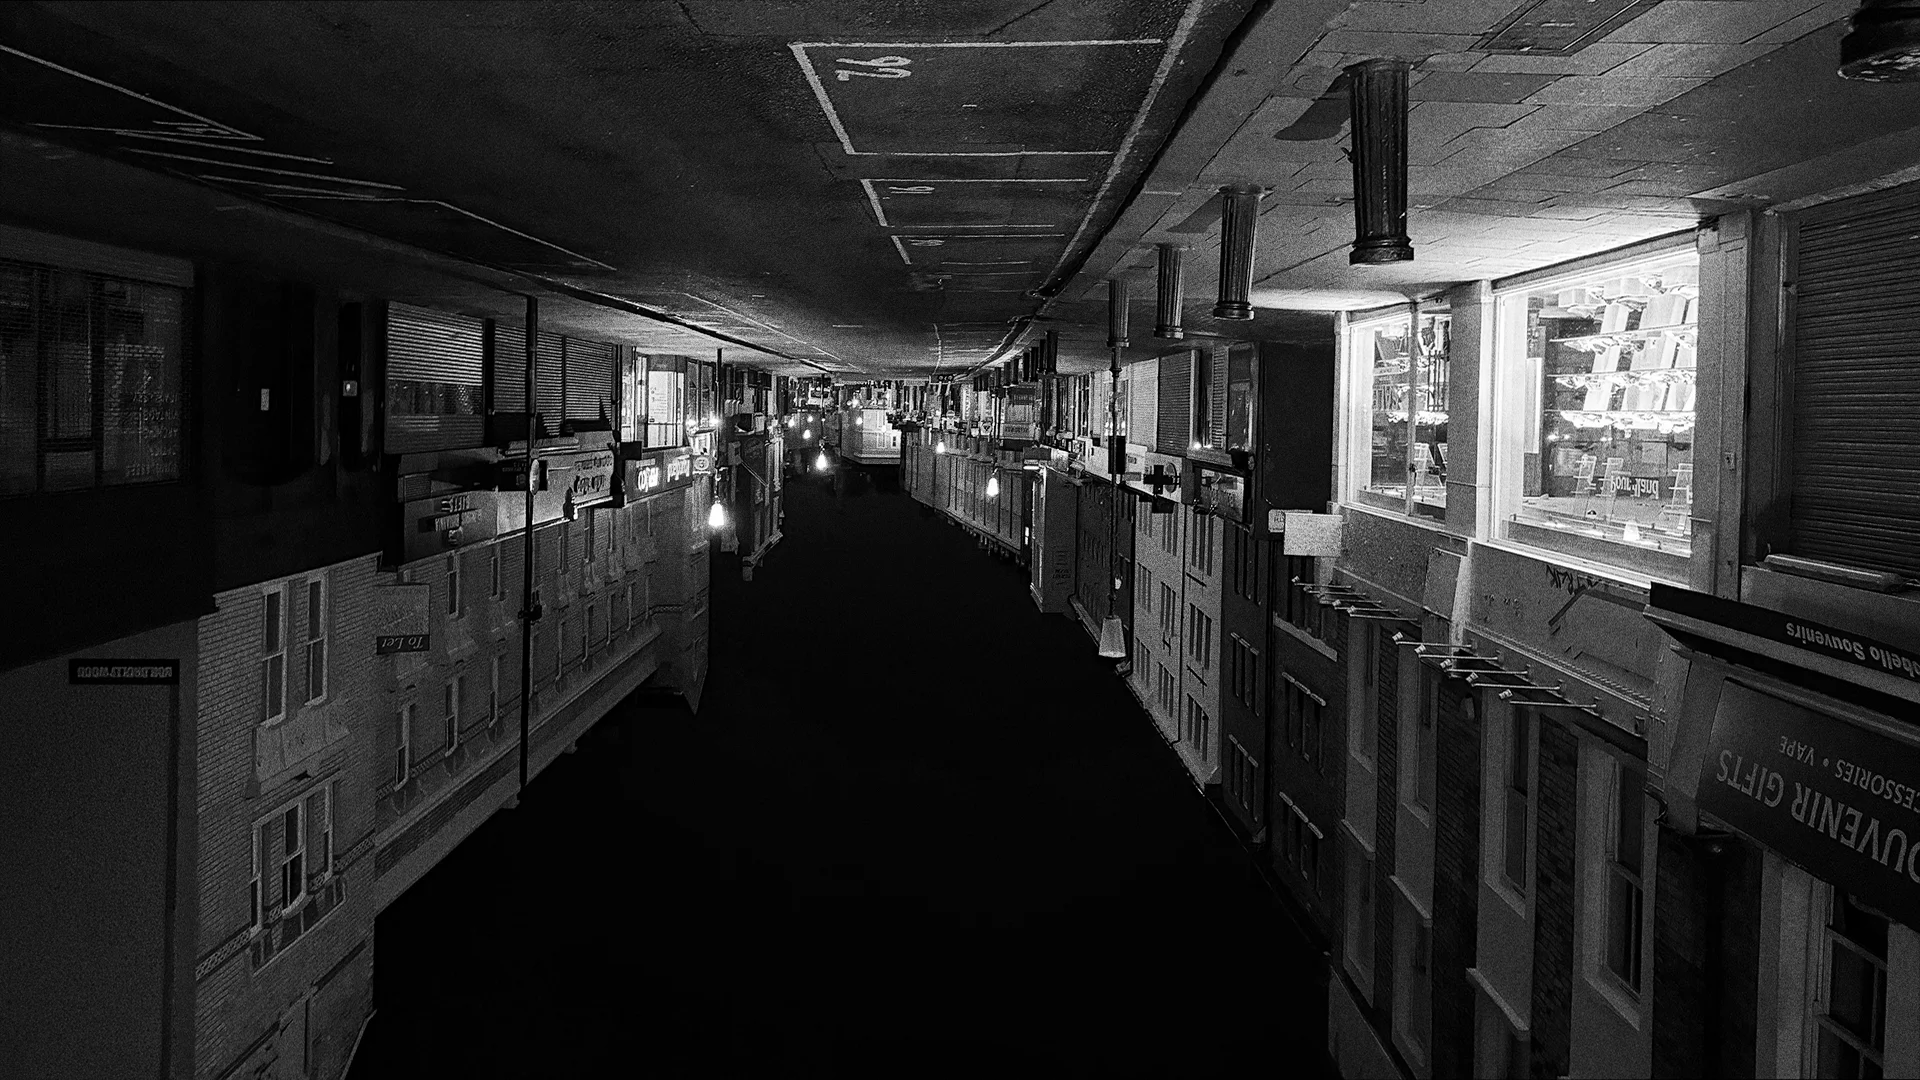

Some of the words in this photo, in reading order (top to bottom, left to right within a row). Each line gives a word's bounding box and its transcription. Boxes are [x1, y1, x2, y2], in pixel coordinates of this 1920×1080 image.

[834, 55, 912, 82] 92
[381, 638, 404, 650] Let
[408, 636, 424, 649] To
[1786, 622, 1865, 660] Souvenirs
[1778, 735, 1814, 766] VAPE
[1716, 749, 1784, 808] GIFTS
